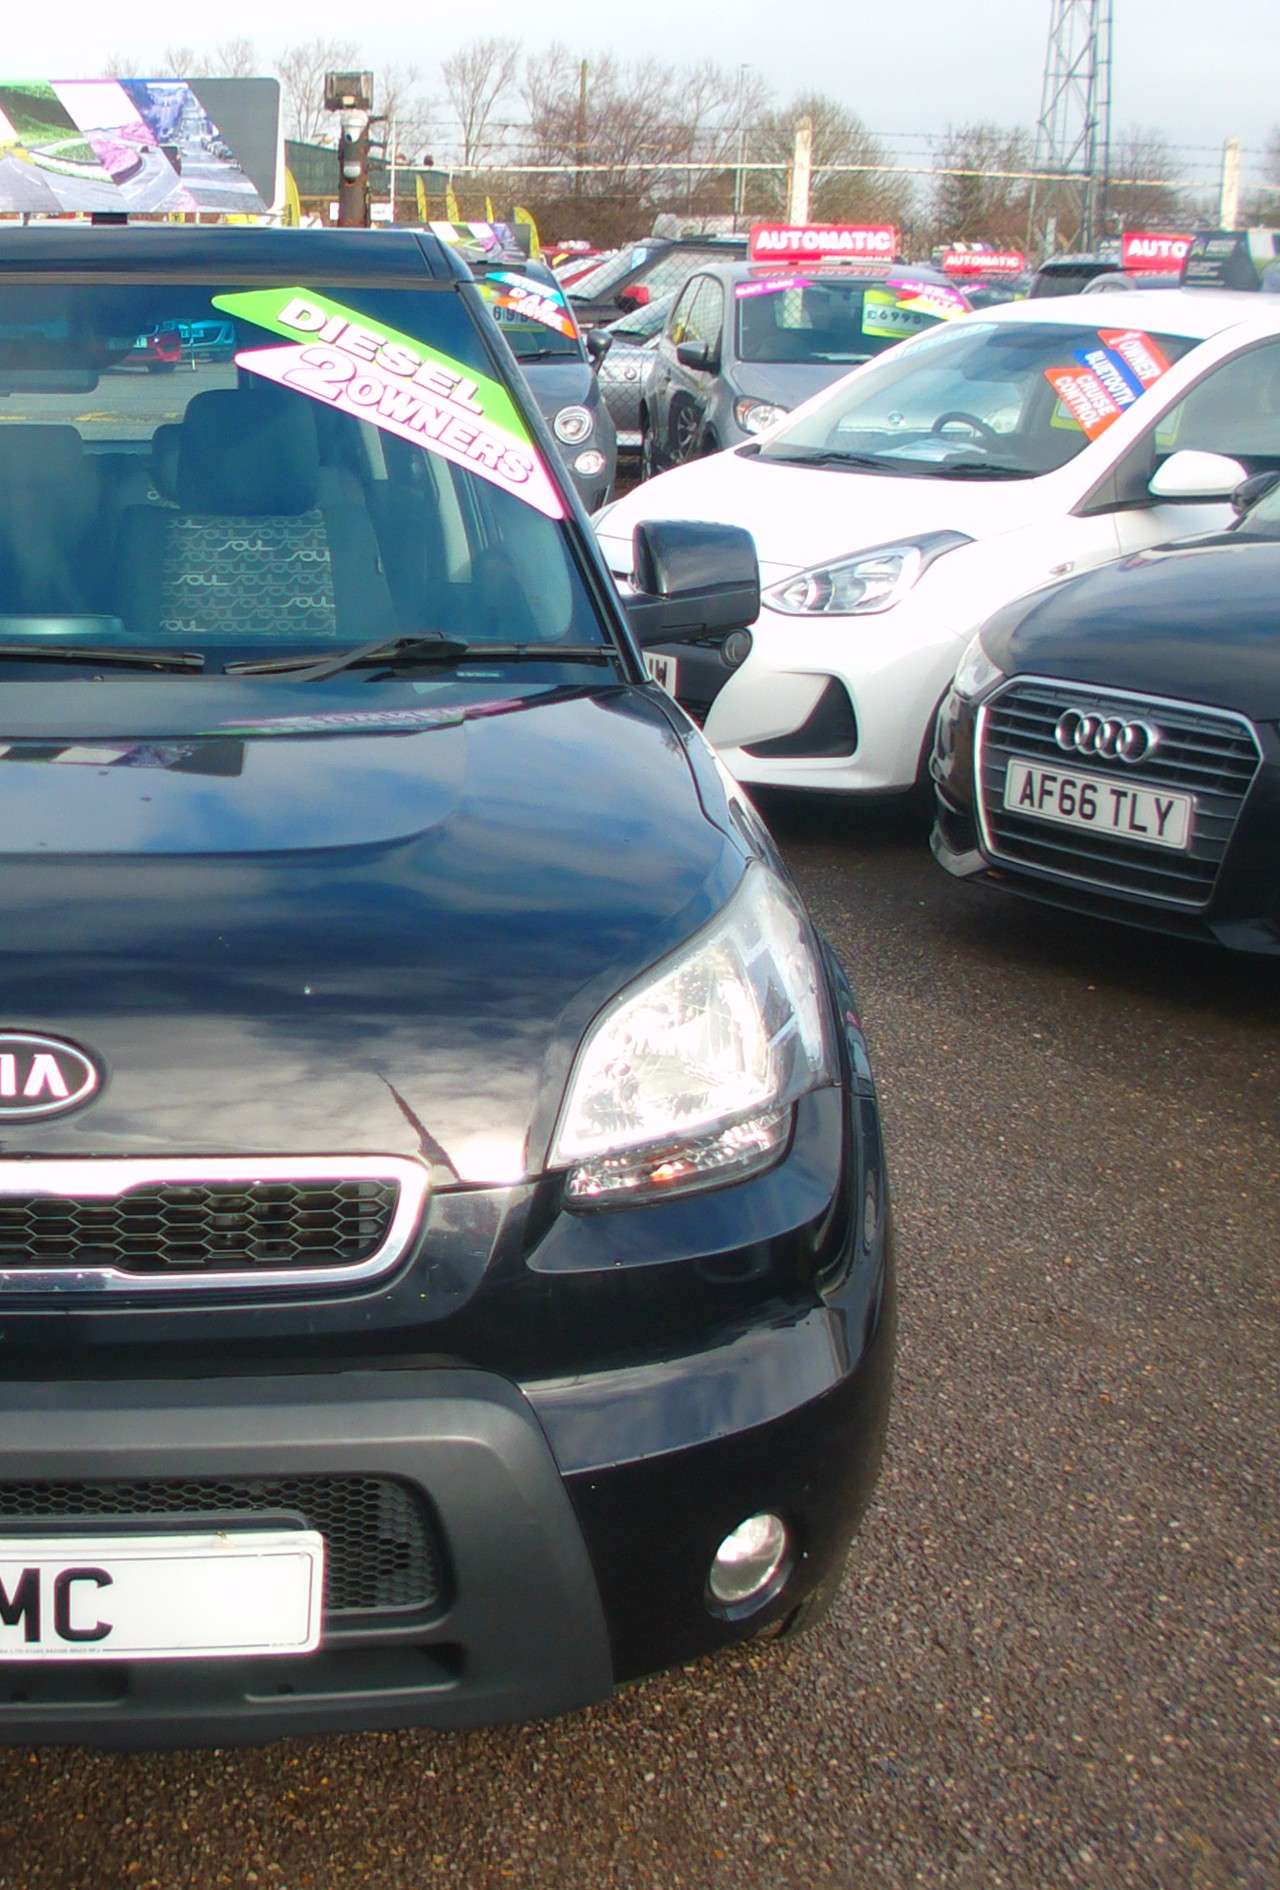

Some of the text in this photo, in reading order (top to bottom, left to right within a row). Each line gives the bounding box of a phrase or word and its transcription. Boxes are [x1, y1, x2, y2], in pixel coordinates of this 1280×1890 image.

[756, 230, 892, 250] AUTOMATIC
[946, 254, 1019, 267] AUTOMATIC
[276, 297, 484, 417] DIESEL
[1084, 350, 1137, 406] BLUETOOTH
[1119, 340, 1162, 381] OWNER
[1055, 376, 1101, 429] CONTROL
[1075, 374, 1117, 417] CRUISE
[1019, 769, 1174, 837] AF66 TLY
